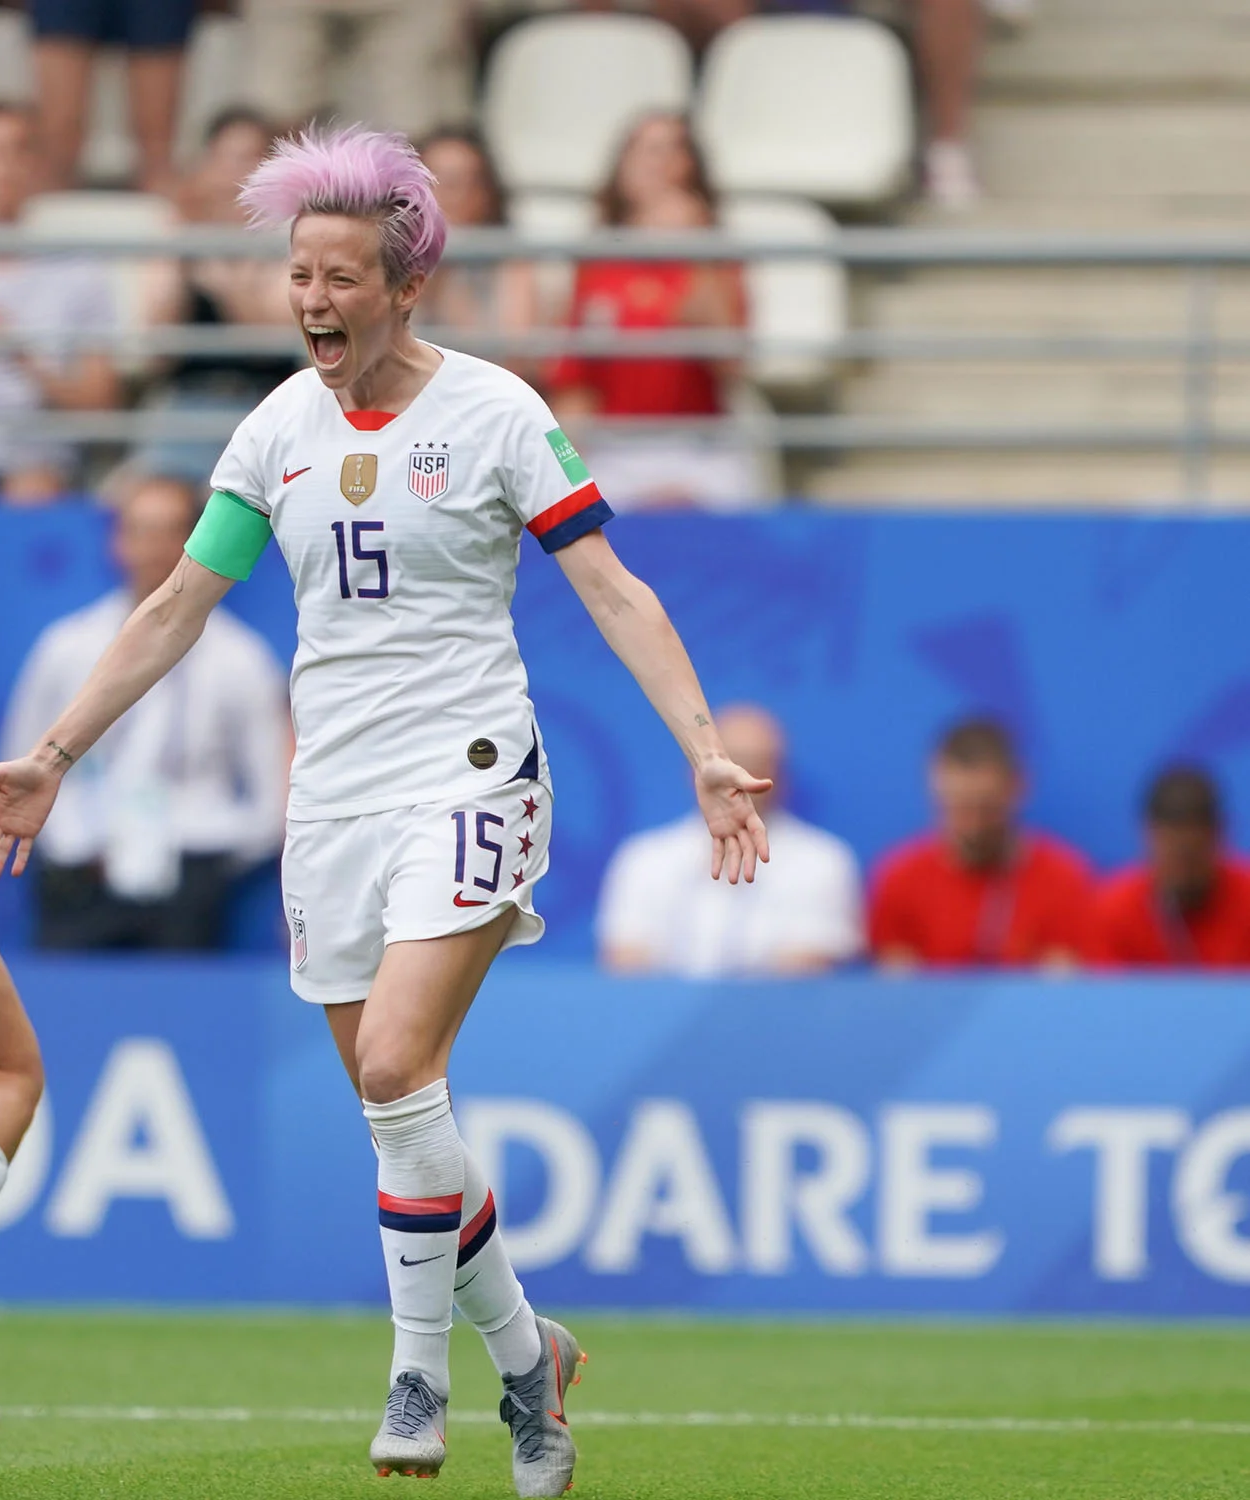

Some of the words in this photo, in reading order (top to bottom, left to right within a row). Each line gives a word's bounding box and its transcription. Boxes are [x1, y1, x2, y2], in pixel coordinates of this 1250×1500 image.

[348, 485, 366, 493] FIFA
[412, 456, 446, 475] USA
[330, 520, 390, 600] 15
[450, 810, 504, 894] 15
[460, 1097, 1004, 1279] DARE
